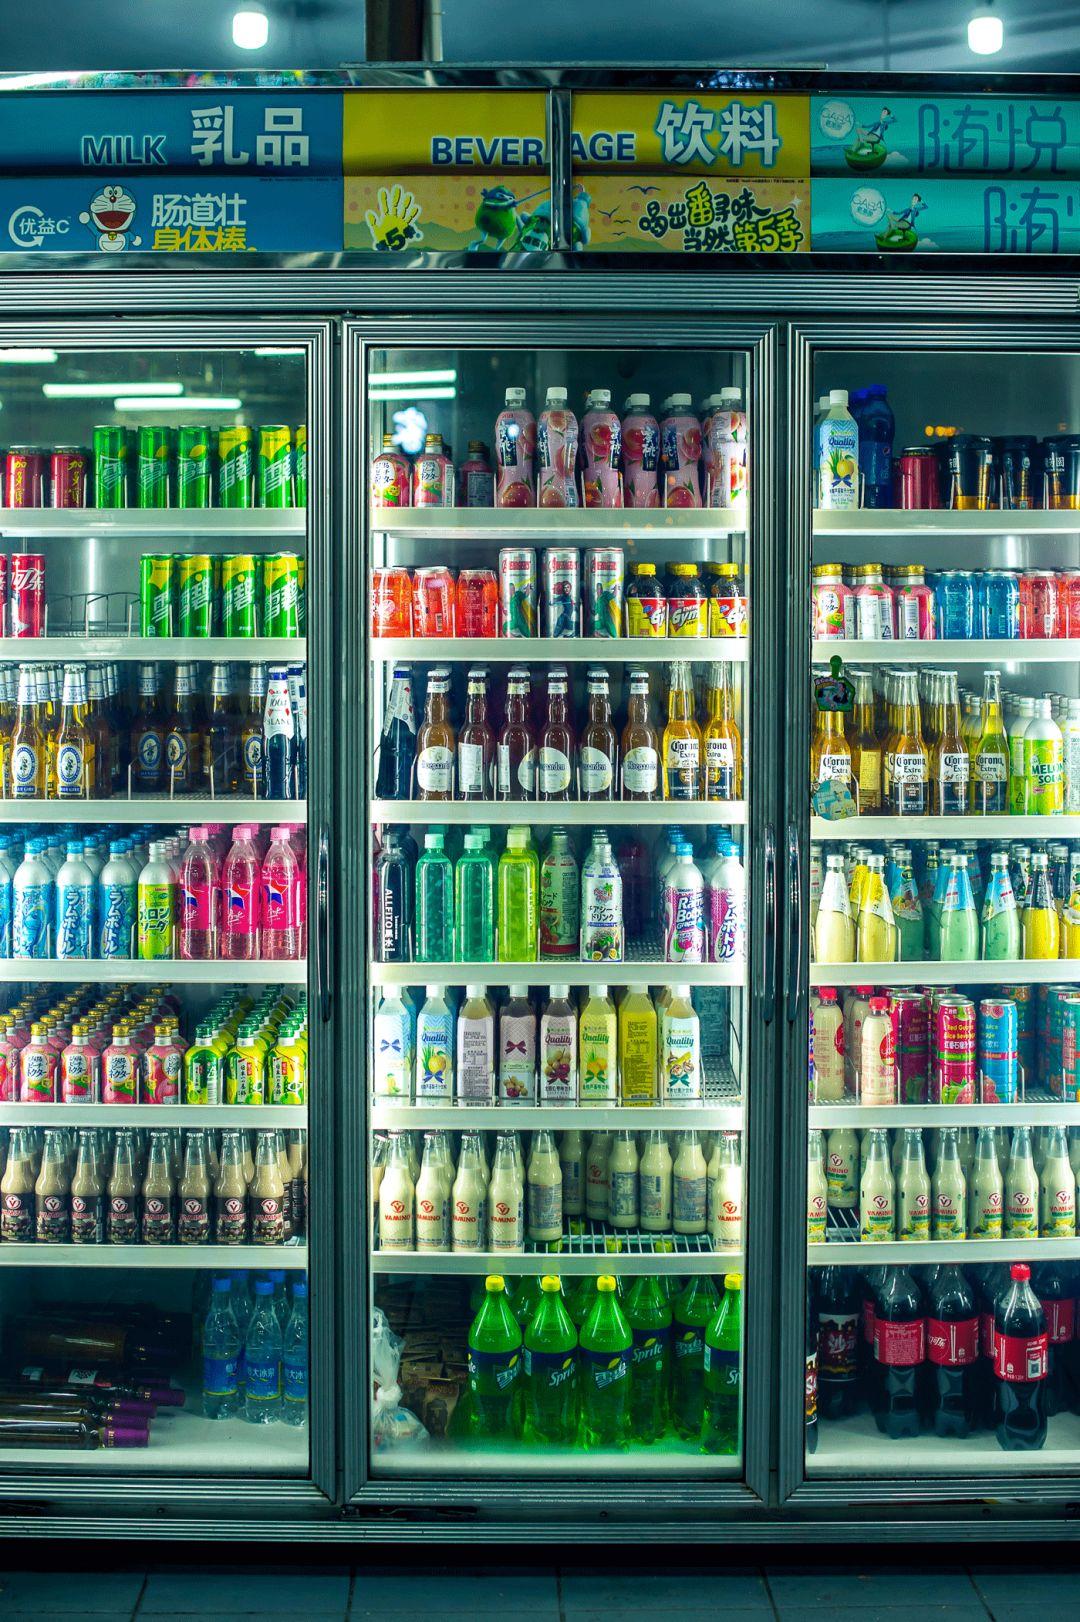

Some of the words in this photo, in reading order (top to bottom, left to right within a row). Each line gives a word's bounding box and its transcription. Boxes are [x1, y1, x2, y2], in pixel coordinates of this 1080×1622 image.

[190, 105, 311, 167] 乳品
[655, 101, 780, 167] 饮料
[81, 134, 167, 166] MILK
[152, 192, 248, 227] 肠道壮
[19, 216, 70, 236] 优益C
[983, 186, 1075, 253] 随
[828, 437, 856, 448] Quality
[706, 742, 728, 750] orona
[896, 756, 926, 767] Corona
[975, 755, 1004, 767] Corona
[62, 891, 81, 954] ラムボトル
[105, 891, 123, 954] ラムボトル
[421, 1033, 448, 1044] Quality
[545, 1034, 573, 1046] Quality
[582, 1034, 610, 1044] Quality
[666, 1036, 694, 1048] Quality
[632, 1344, 663, 1363] Sprite
